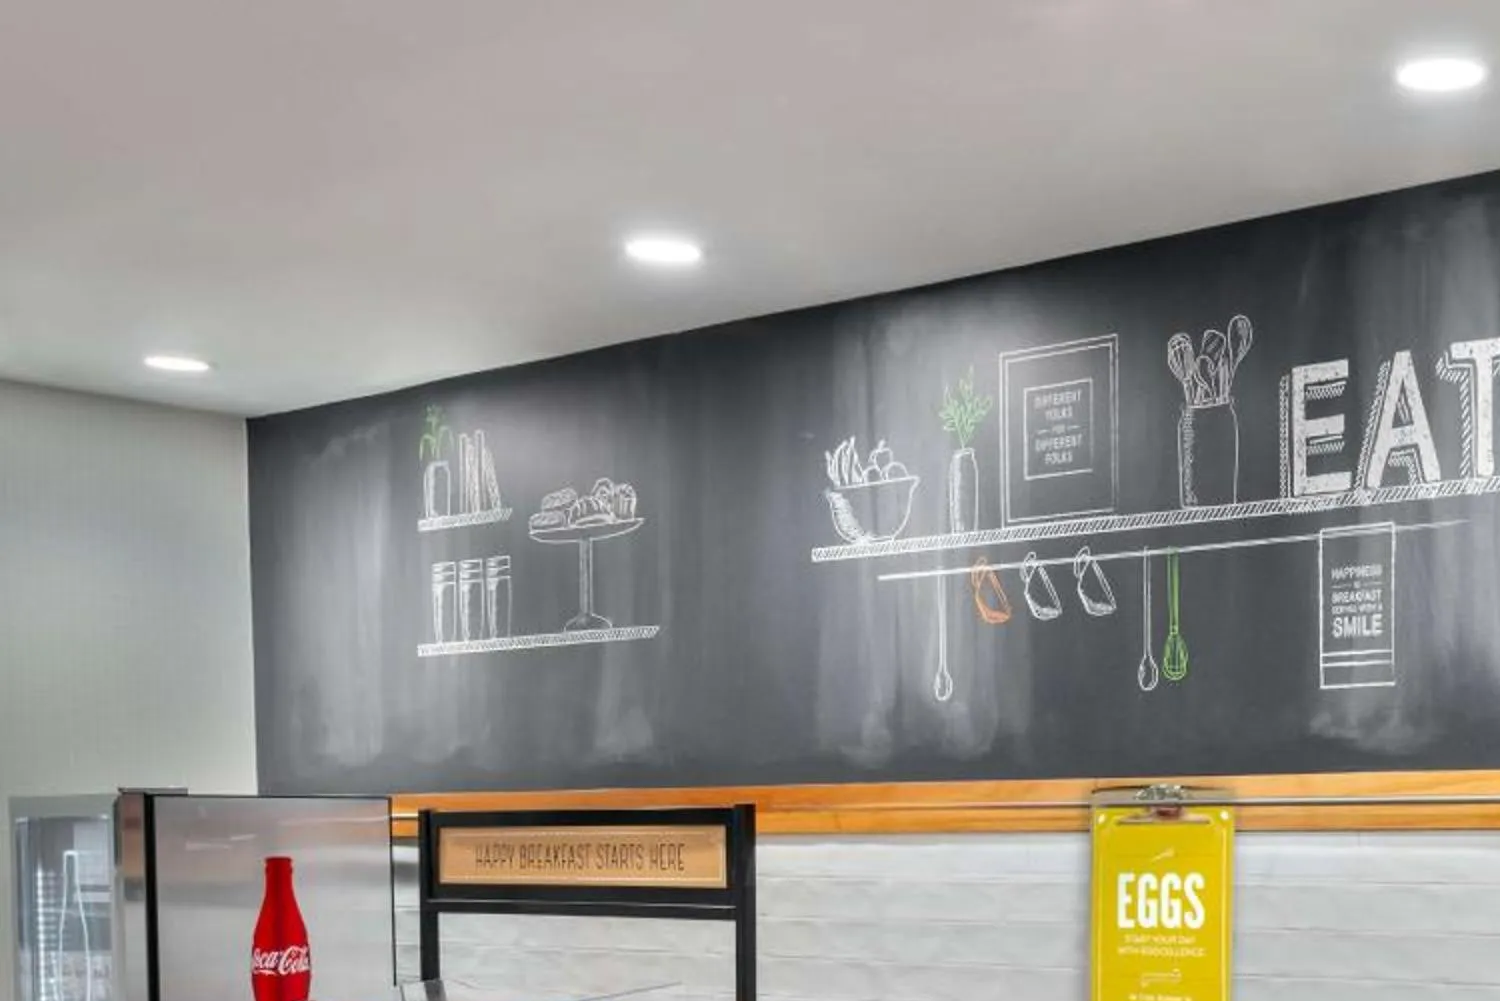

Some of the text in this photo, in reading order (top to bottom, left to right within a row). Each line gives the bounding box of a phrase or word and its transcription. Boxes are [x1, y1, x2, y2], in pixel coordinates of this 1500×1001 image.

[1331, 590, 1382, 604] BREAKFAST
[1331, 613, 1383, 638] SMILE
[475, 843, 685, 871] HAPPY BREAKFAST STARTS HERE
[1117, 872, 1205, 929] EGGS
